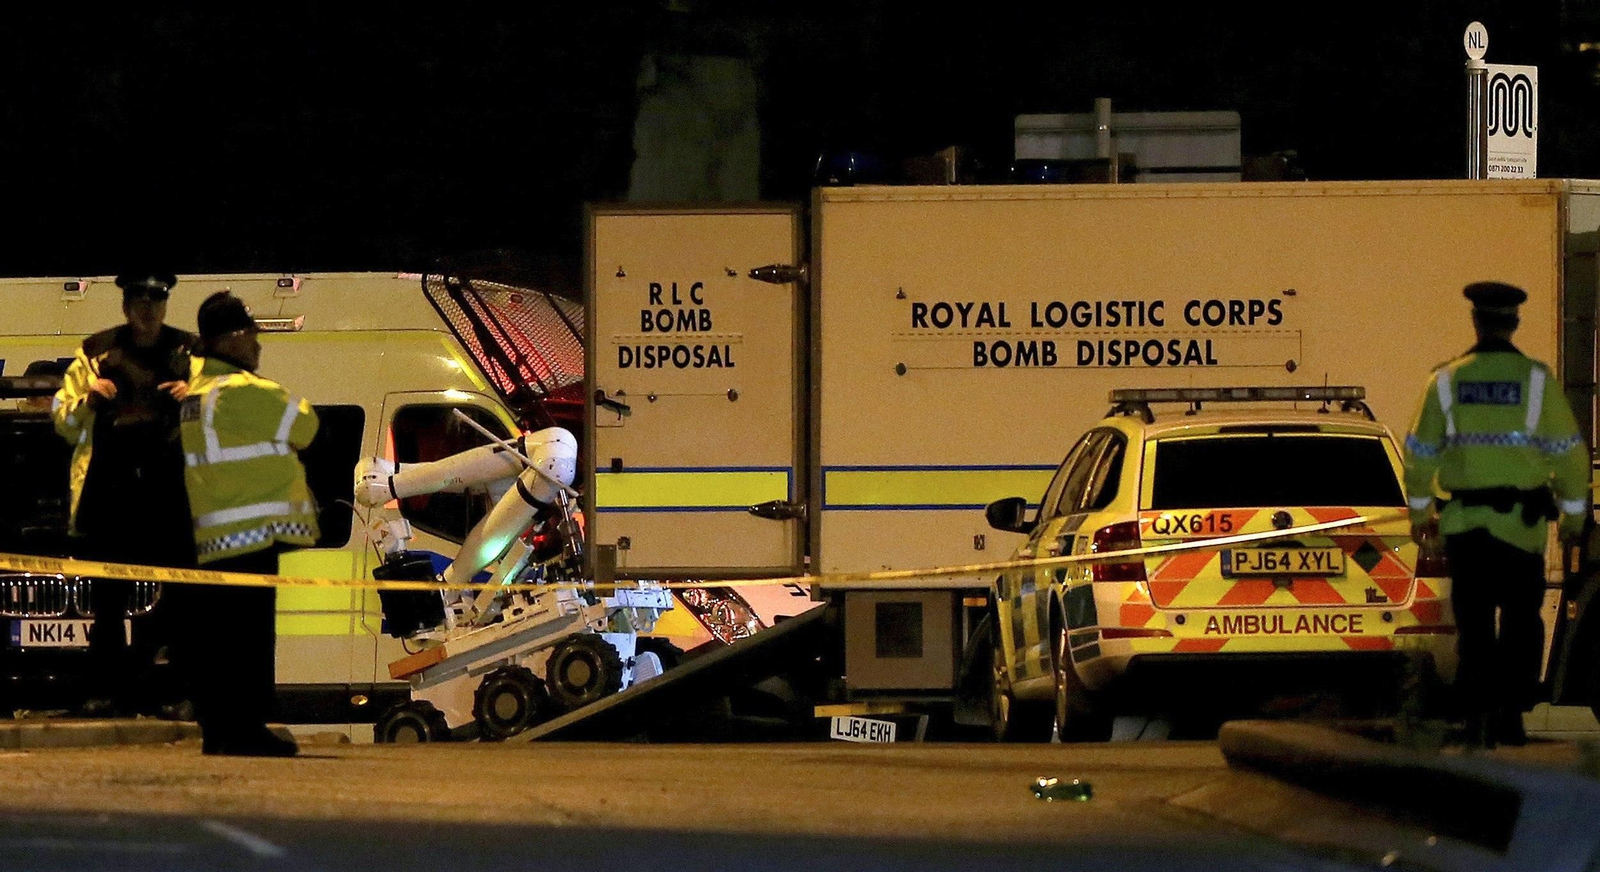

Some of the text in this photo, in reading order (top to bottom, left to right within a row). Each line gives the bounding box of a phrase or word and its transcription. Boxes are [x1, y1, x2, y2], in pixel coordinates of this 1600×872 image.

[1468, 31, 1485, 49] NL
[641, 309, 712, 332] BOMB
[912, 299, 1282, 329] ROYAL LOGISTIC CORPS
[618, 345, 735, 369] DISPOSAL
[973, 339, 1218, 367] BOMB DISPOSAL
[1152, 513, 1233, 535] QX615
[1235, 550, 1340, 572] PJ64 XYL
[29, 623, 76, 643] NK14
[1204, 614, 1364, 635] AMBULANCE
[836, 717, 891, 743] LJ64 EKH
